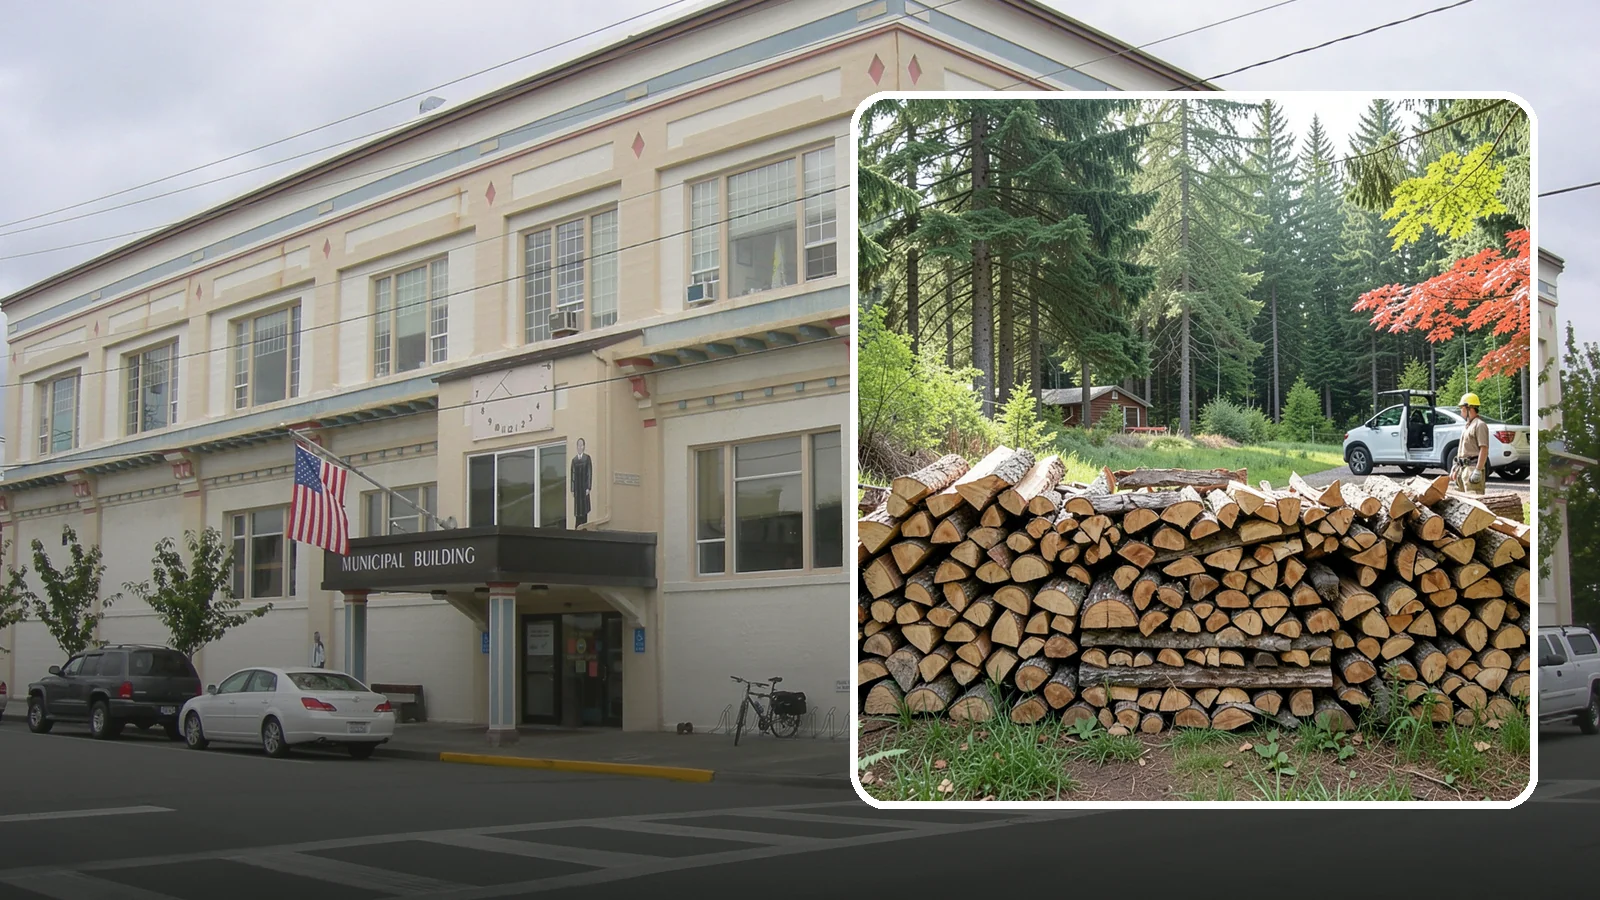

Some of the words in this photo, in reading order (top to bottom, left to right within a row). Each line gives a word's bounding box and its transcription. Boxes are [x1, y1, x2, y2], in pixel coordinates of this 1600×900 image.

[536, 402, 540, 410] 4
[480, 407, 485, 415] 8
[487, 417, 492, 426] 9
[528, 414, 533, 422] 3
[521, 420, 526, 428] 2
[507, 425, 513, 433] 12
[342, 552, 405, 572] MUNICIPAL
[414, 546, 475, 567] BUILDING
